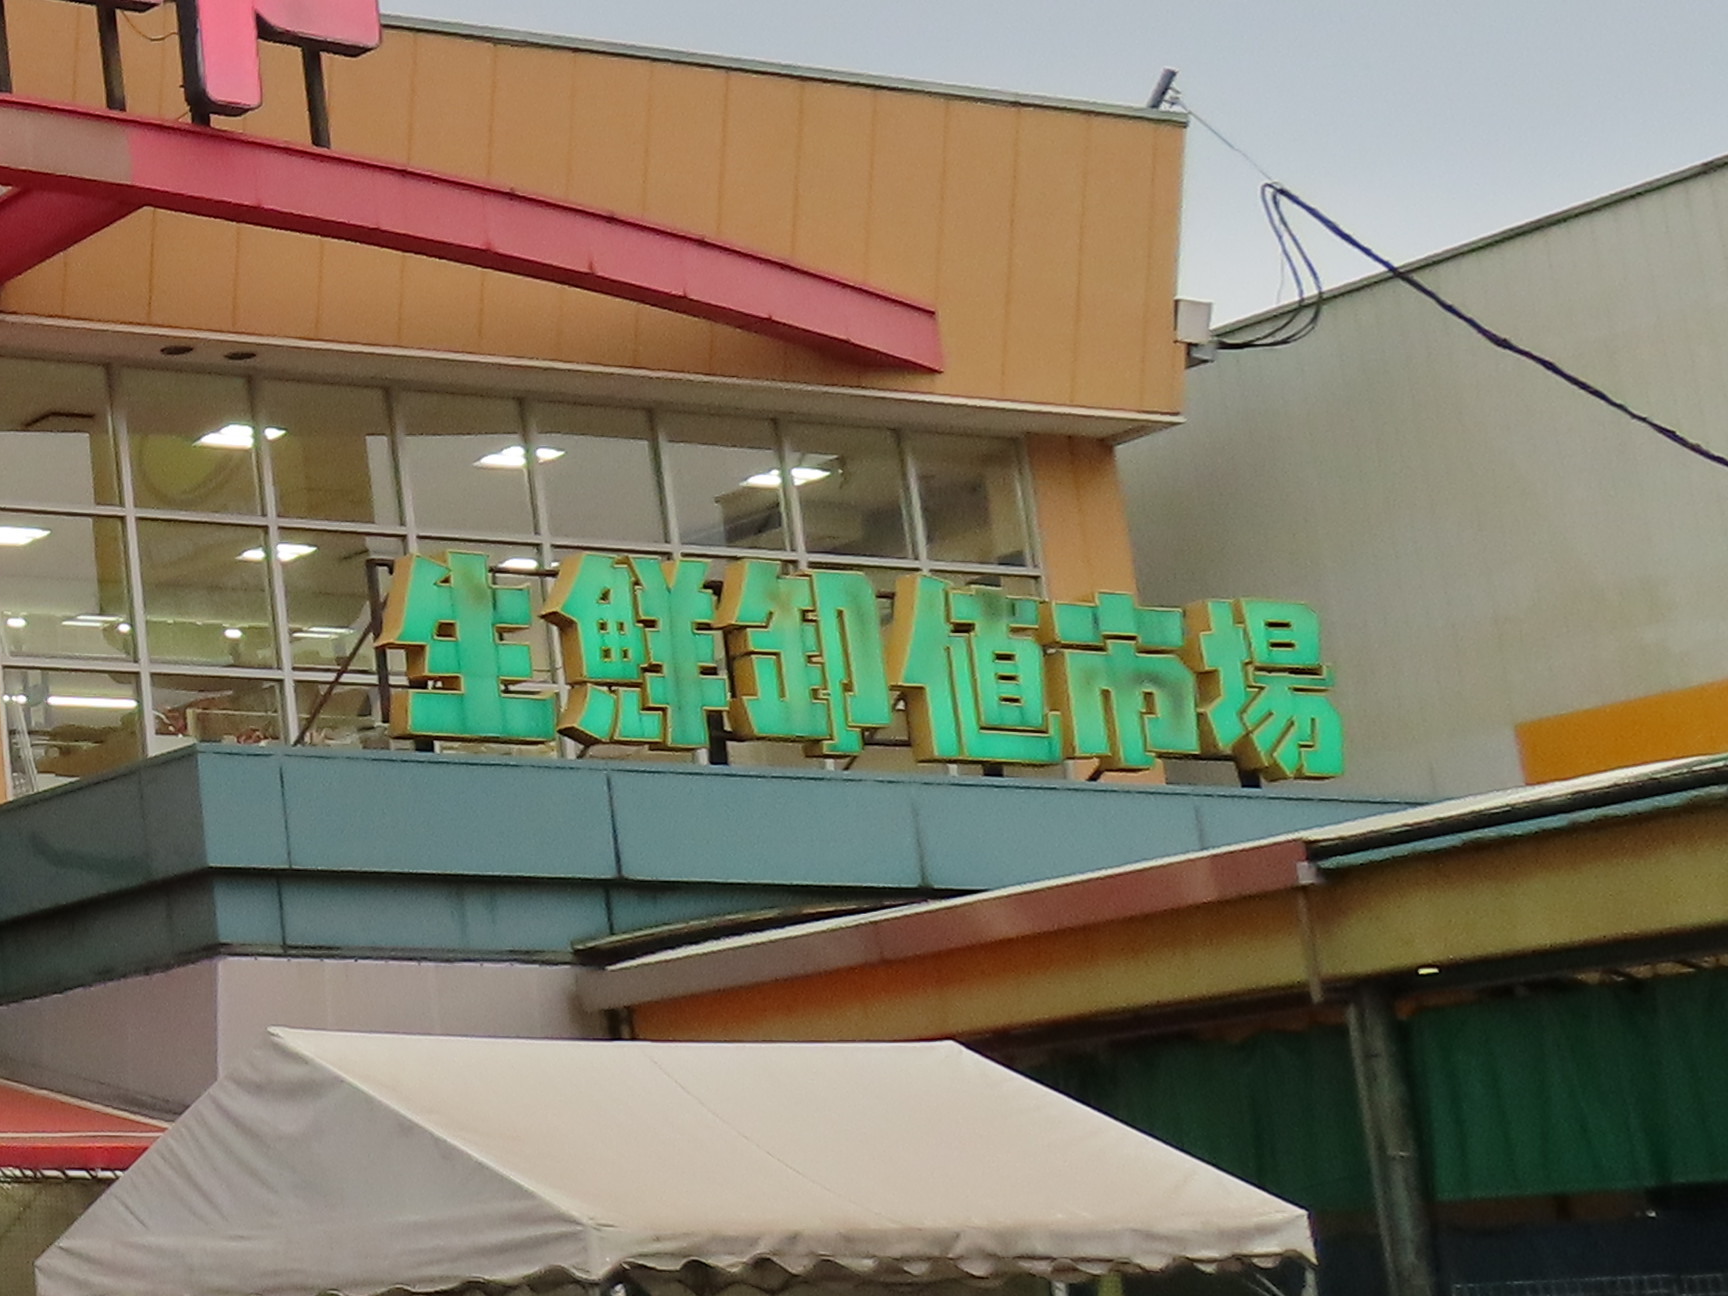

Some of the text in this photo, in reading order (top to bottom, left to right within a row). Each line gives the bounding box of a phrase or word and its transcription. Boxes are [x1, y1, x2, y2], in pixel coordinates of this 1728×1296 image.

[373, 550, 1346, 782] 生鮮卸値市場
